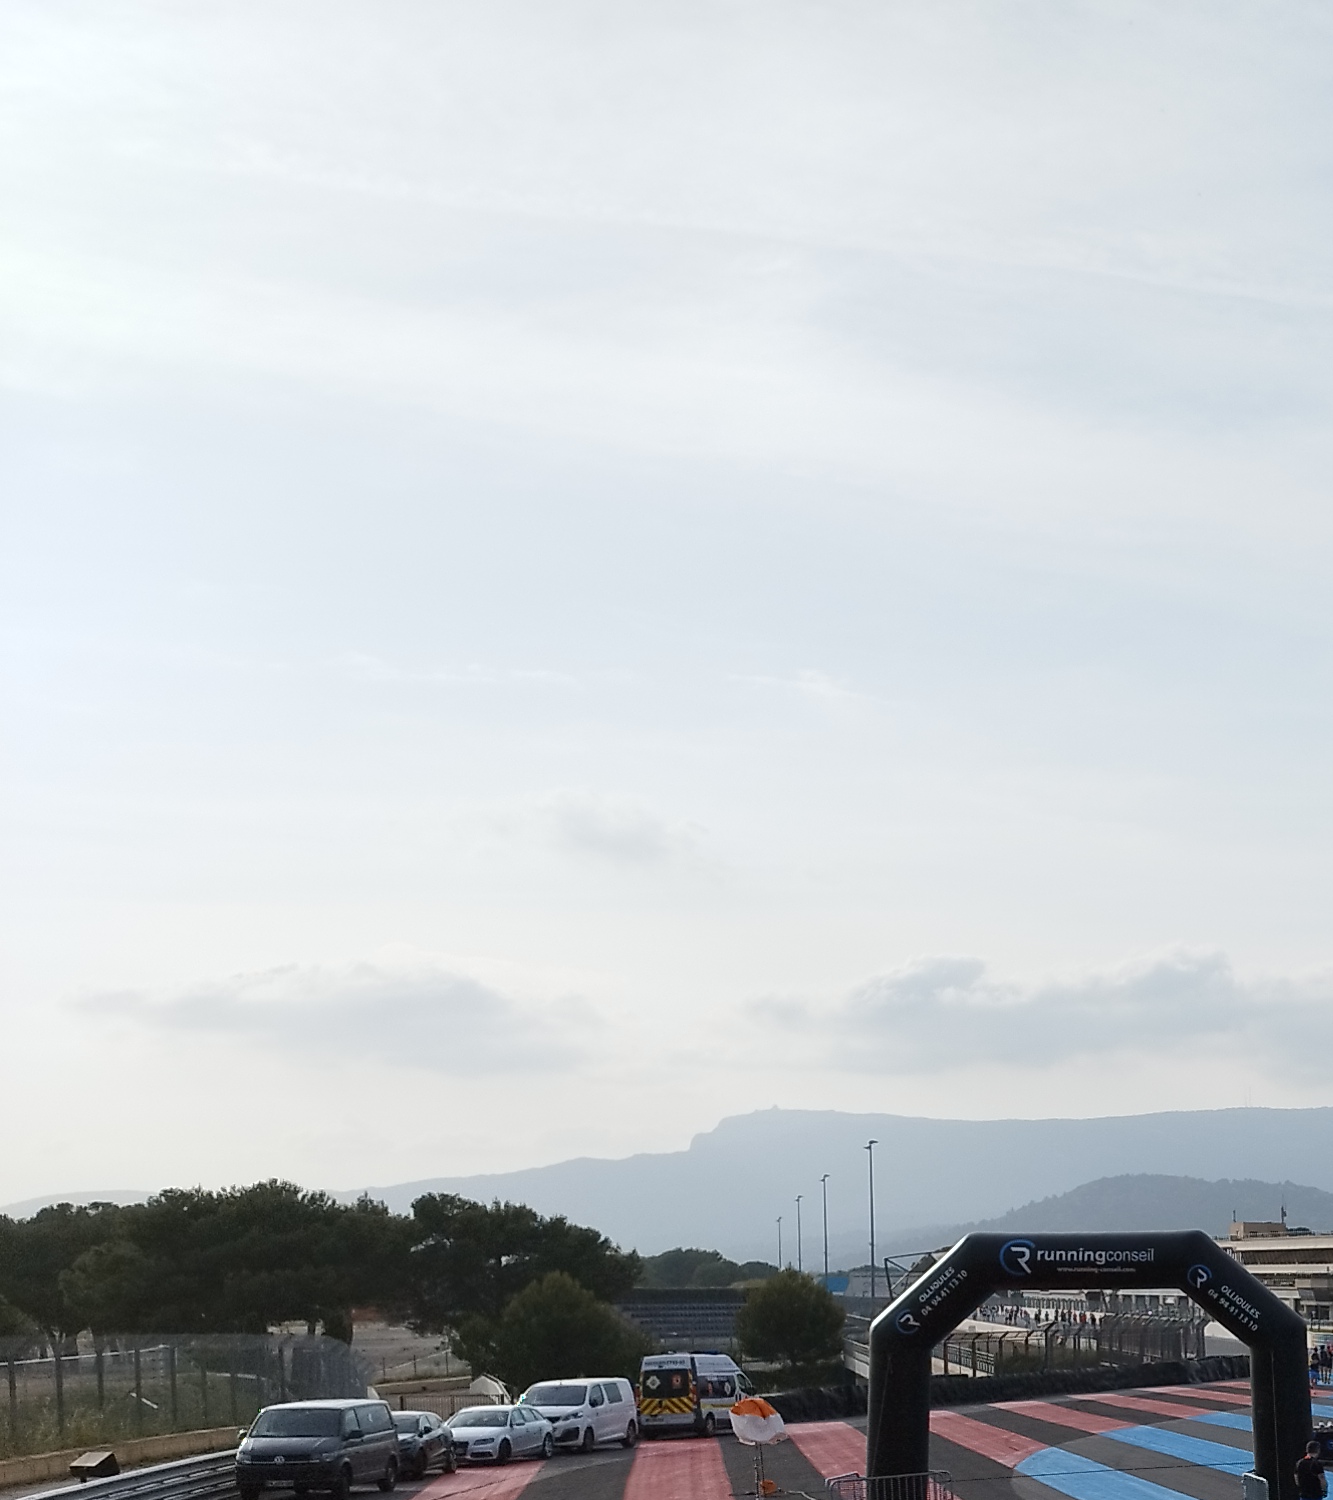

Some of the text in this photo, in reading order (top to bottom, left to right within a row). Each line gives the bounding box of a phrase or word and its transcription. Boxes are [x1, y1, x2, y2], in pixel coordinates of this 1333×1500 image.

[1037, 1247, 1154, 1265] runningconseil
[919, 1266, 955, 1302] OLLIOULES
[1221, 1285, 1262, 1319] OLLIOULES
